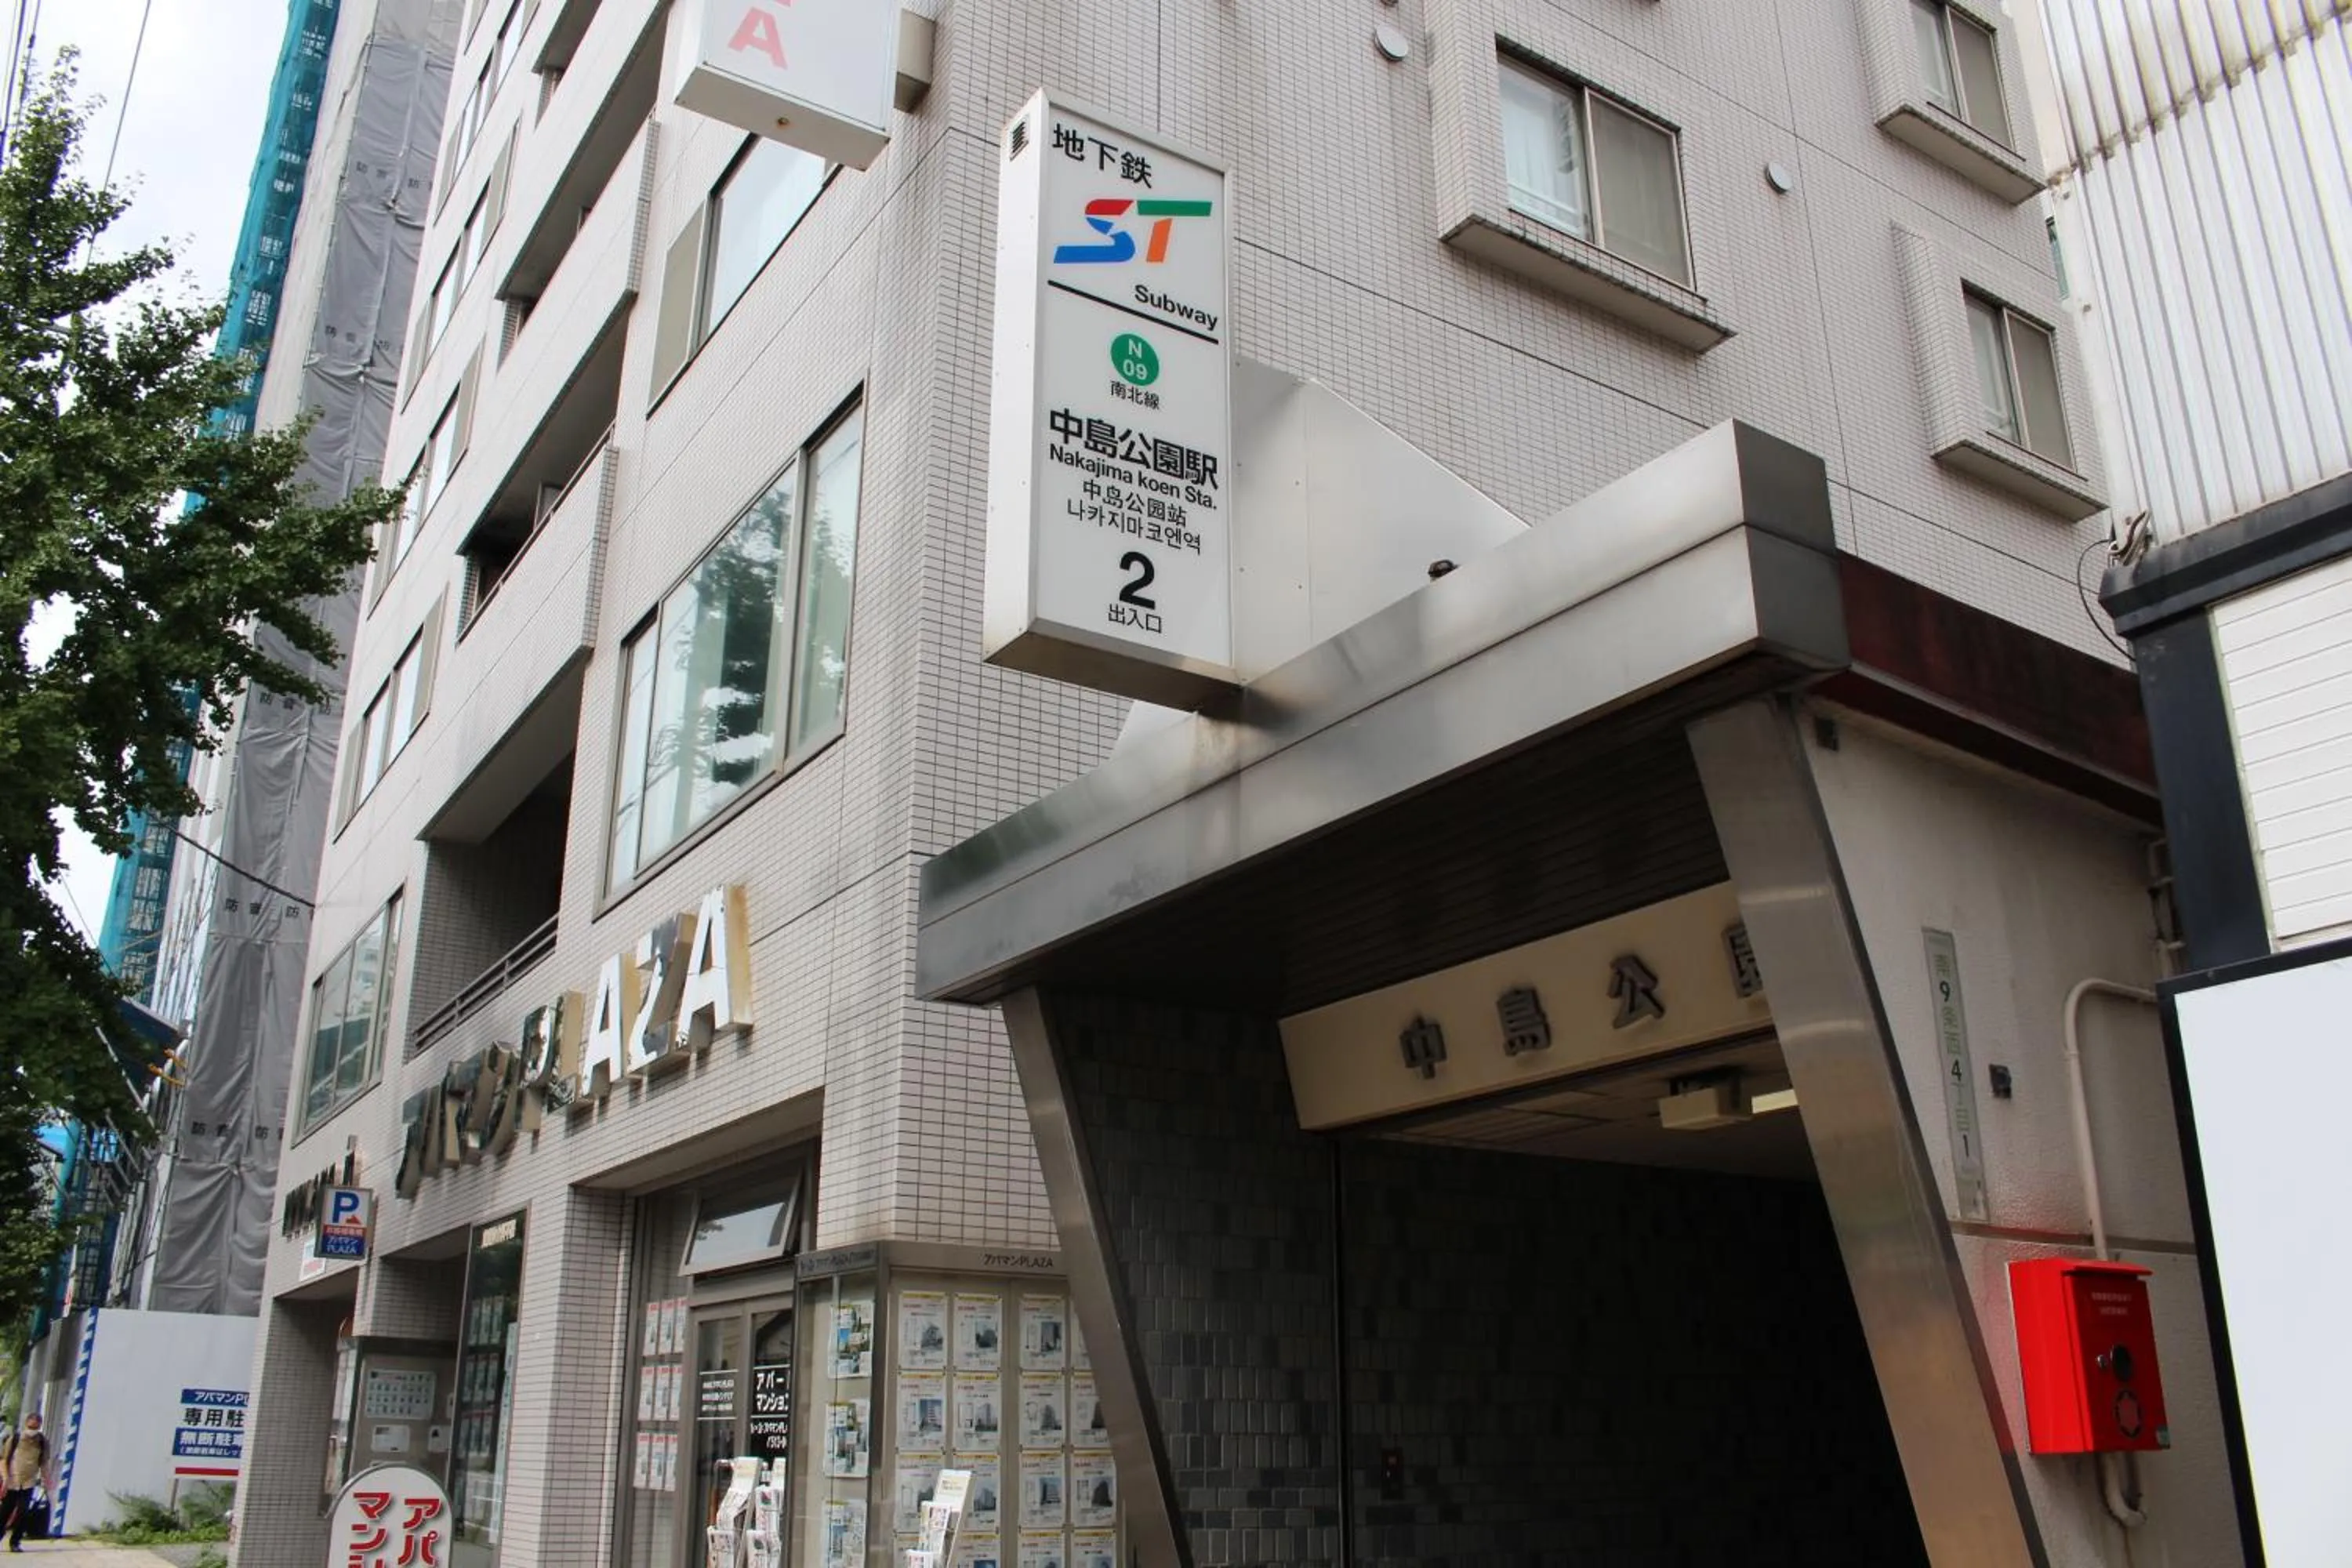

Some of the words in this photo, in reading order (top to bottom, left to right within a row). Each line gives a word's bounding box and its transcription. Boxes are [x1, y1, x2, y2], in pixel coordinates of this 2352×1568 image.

[1052, 123, 1152, 188] 地下鉄
[1134, 284, 1218, 331] Subway
[1123, 359, 1147, 380] 09
[1128, 338, 1142, 359] N
[1110, 379, 1160, 410] 南北線
[1050, 408, 1218, 490] 中島公園駅
[1049, 443, 1133, 485] Nakajima
[1138, 470, 1180, 499] koen
[1185, 486, 1218, 510] Sta.
[1083, 479, 1187, 527] 中岛公园站
[1067, 499, 1201, 556] 나카지마코엔역
[1119, 550, 1156, 610] 2
[1108, 603, 1162, 633] 出入口
[332, 1191, 359, 1223] P
[397, 1498, 441, 1566] アパ
